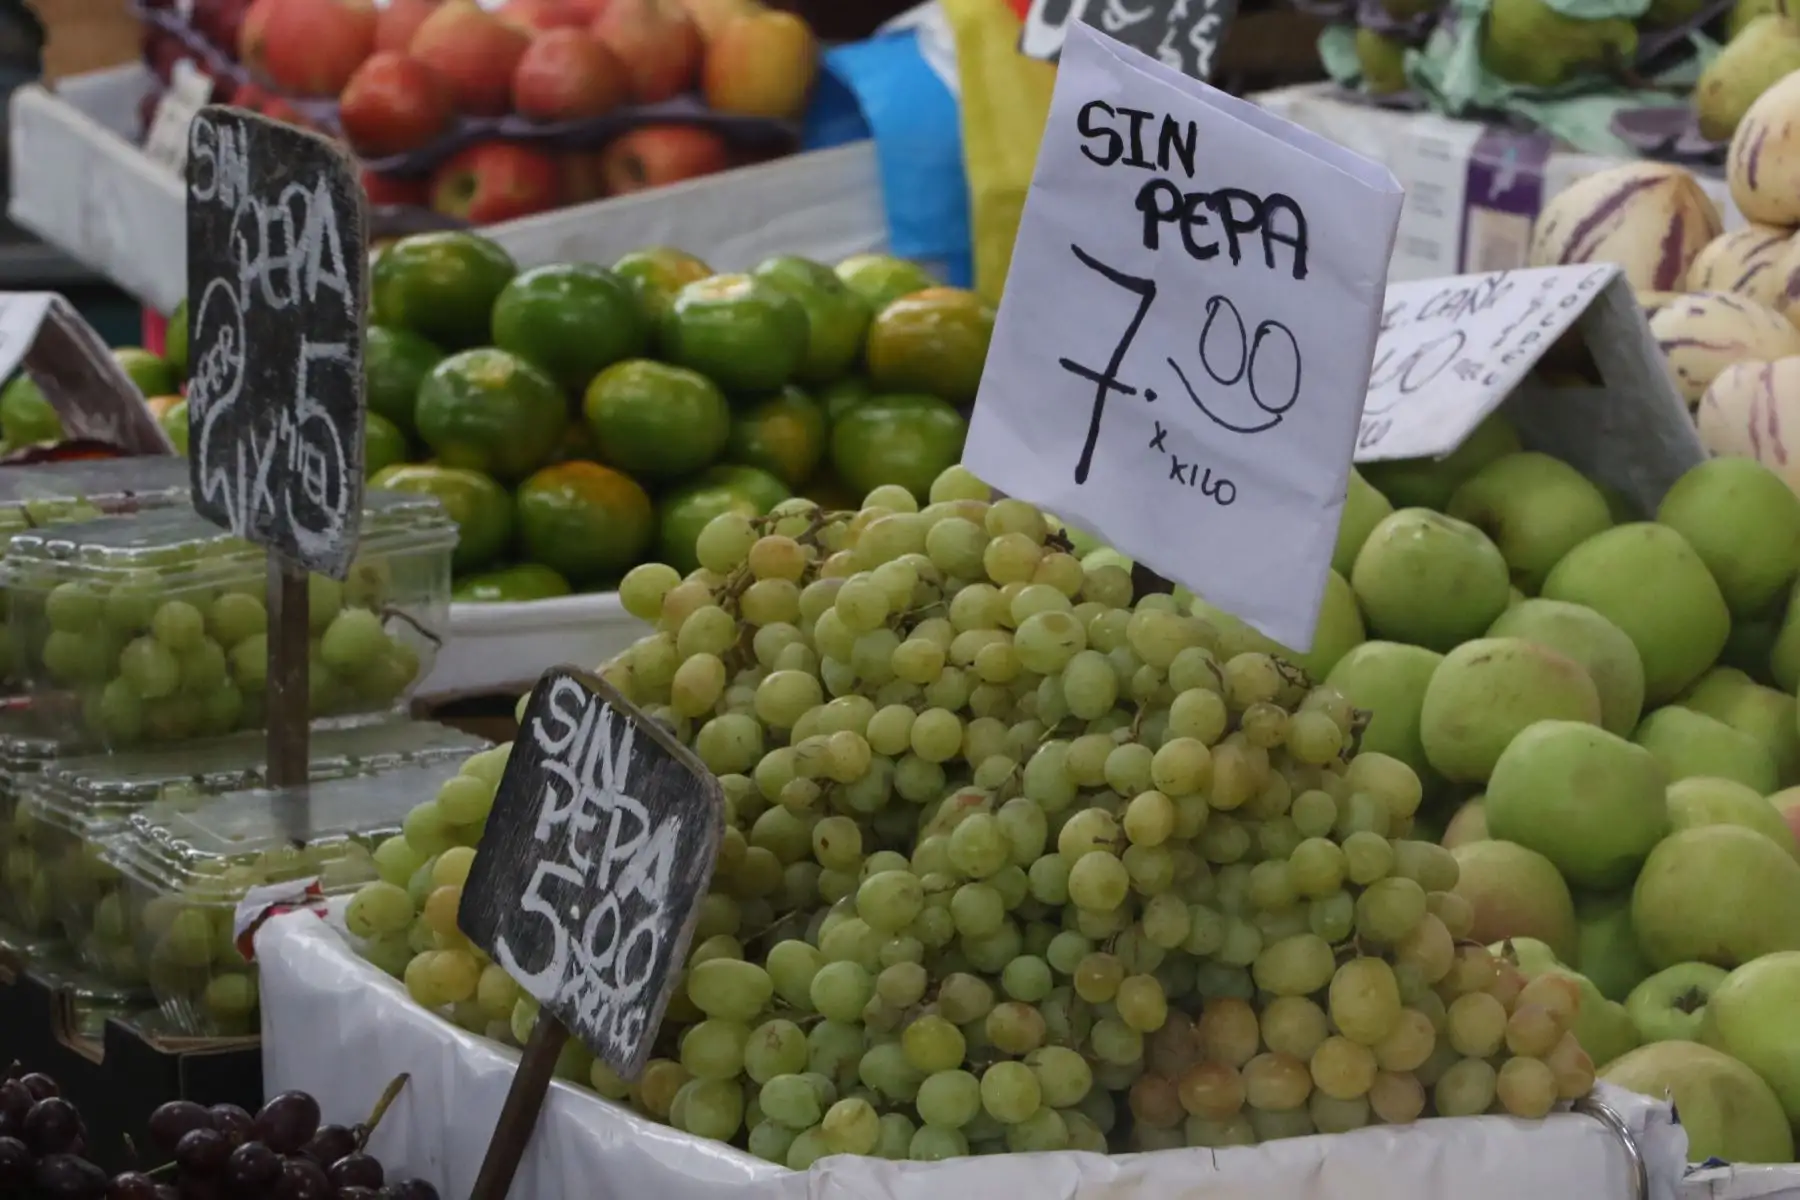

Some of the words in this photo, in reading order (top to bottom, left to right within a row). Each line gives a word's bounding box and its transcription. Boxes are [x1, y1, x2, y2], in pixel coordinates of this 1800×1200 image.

[191, 115, 249, 207] SIN
[1076, 100, 1198, 179] SIN
[230, 173, 355, 317] PEPA
[1134, 177, 1309, 281] PEPA
[533, 675, 638, 794] SIN
[534, 759, 683, 903] PEPA
